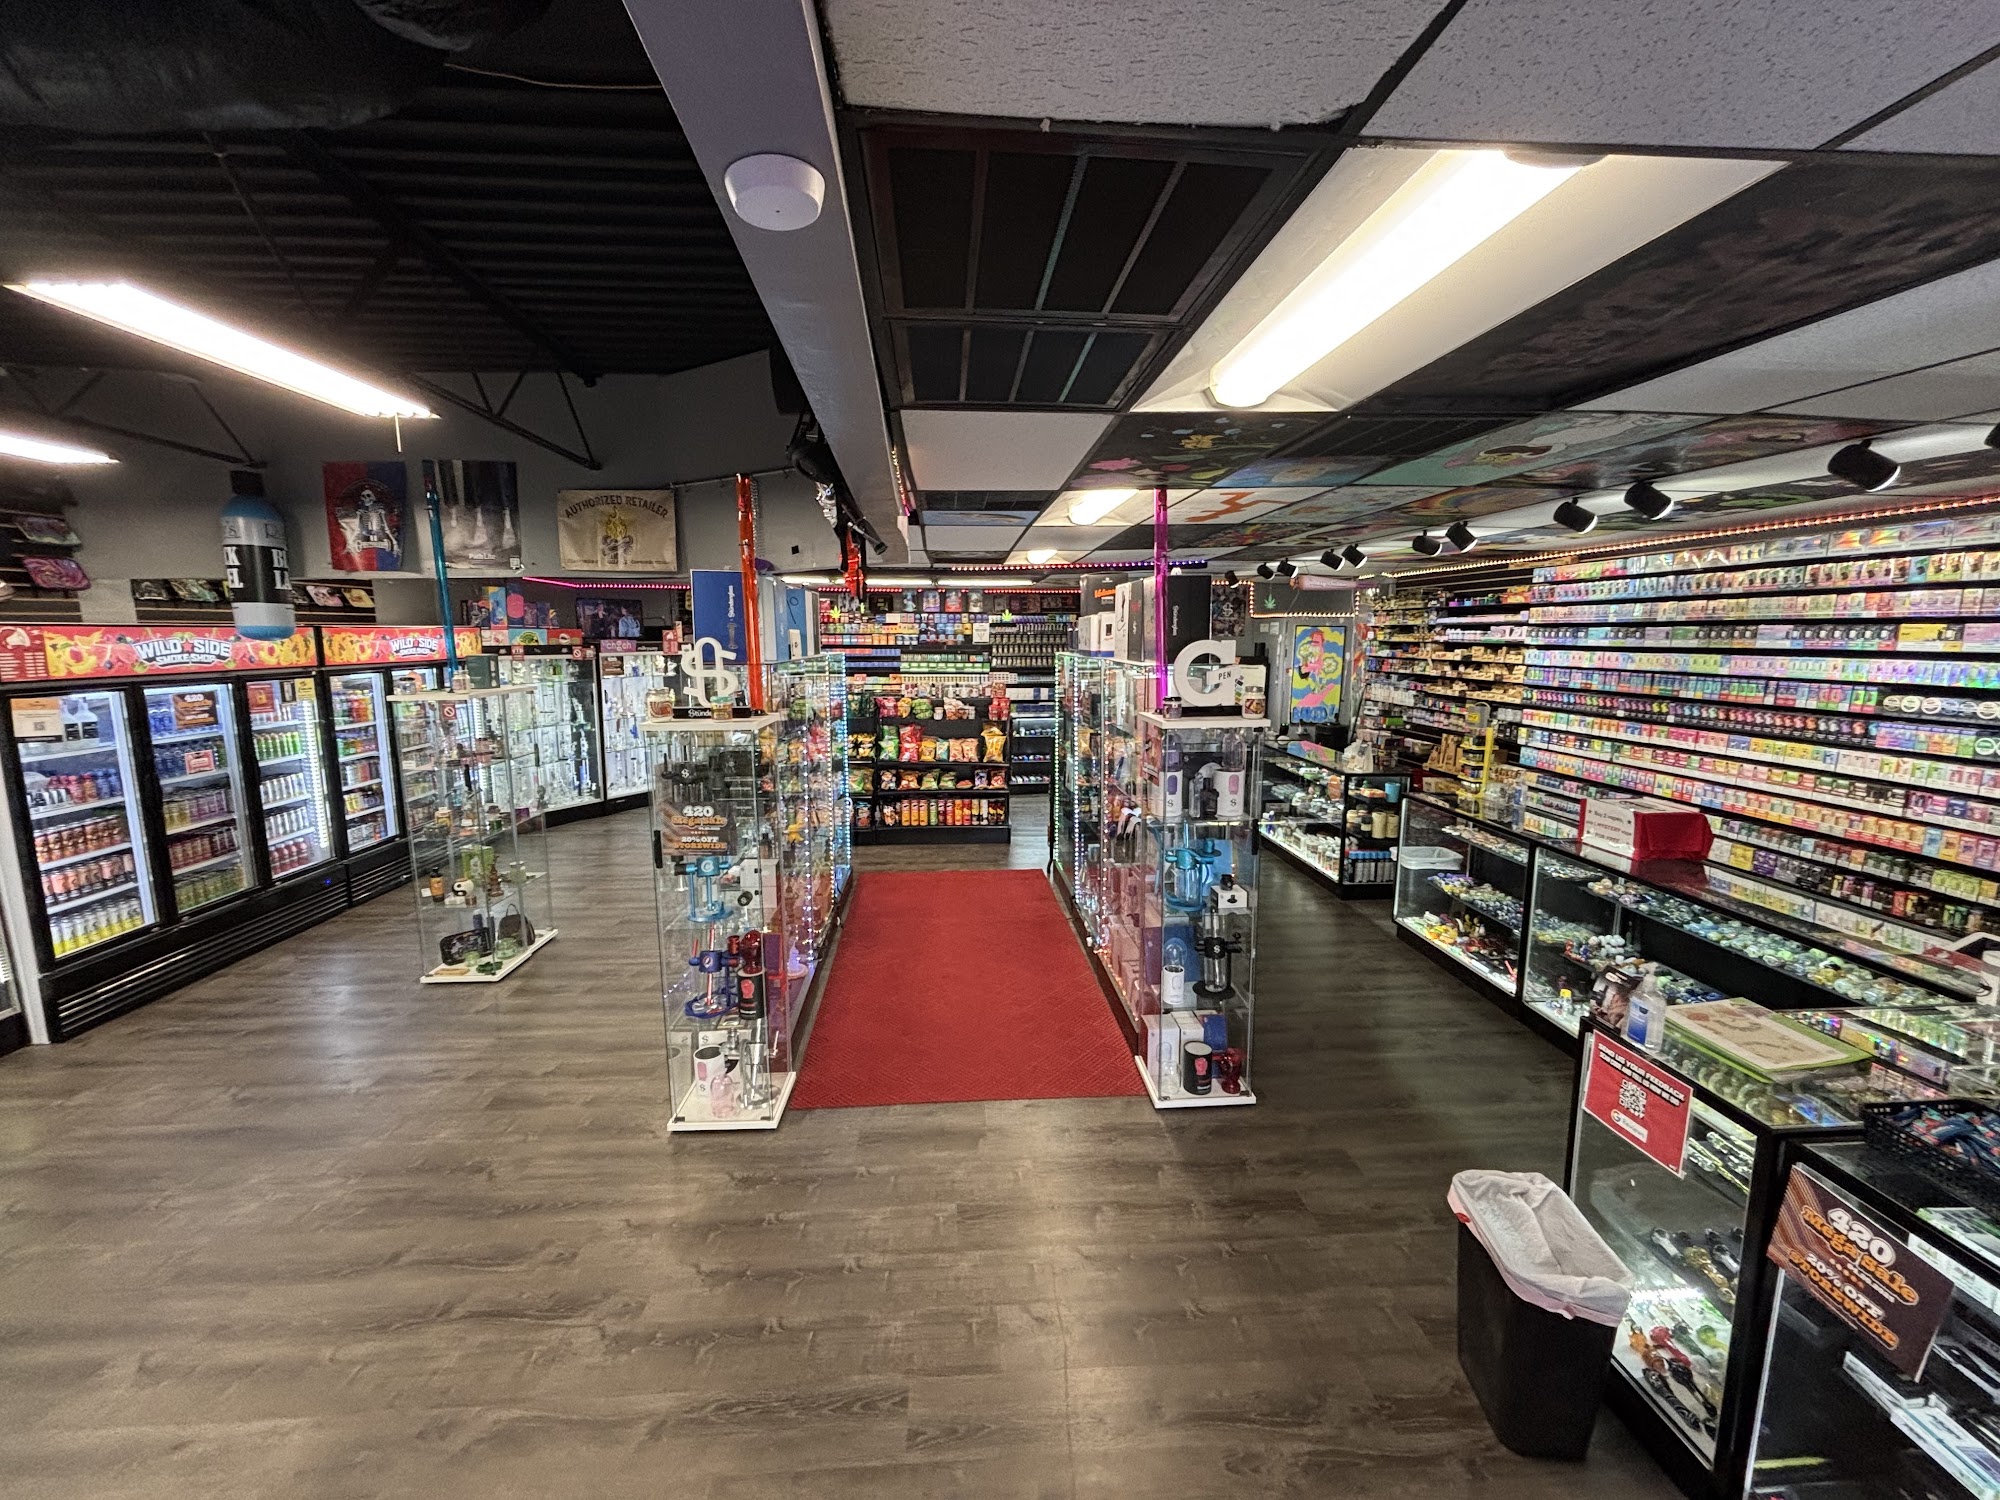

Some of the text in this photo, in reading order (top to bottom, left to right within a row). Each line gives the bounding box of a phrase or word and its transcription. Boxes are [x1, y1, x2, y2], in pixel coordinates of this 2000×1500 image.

[565, 495, 668, 519] AUTHORIZED RETAILER
[135, 639, 231, 659] WILD SIDE
[390, 638, 439, 651] WILD SIDE
[1219, 671, 1231, 680] PEN
[683, 805, 714, 817] 420
[1626, 1060, 1646, 1077] YOUR
[1646, 1072, 1685, 1101] FEEDBACK
[1828, 1209, 1893, 1265] 420
[1802, 1208, 1859, 1259] Mega
[1860, 1254, 1916, 1303] Sale
[1790, 1250, 1897, 1346] STOREWIDE
[1806, 1253, 1841, 1288] 20%
[1843, 1285, 1883, 1318] OFF
